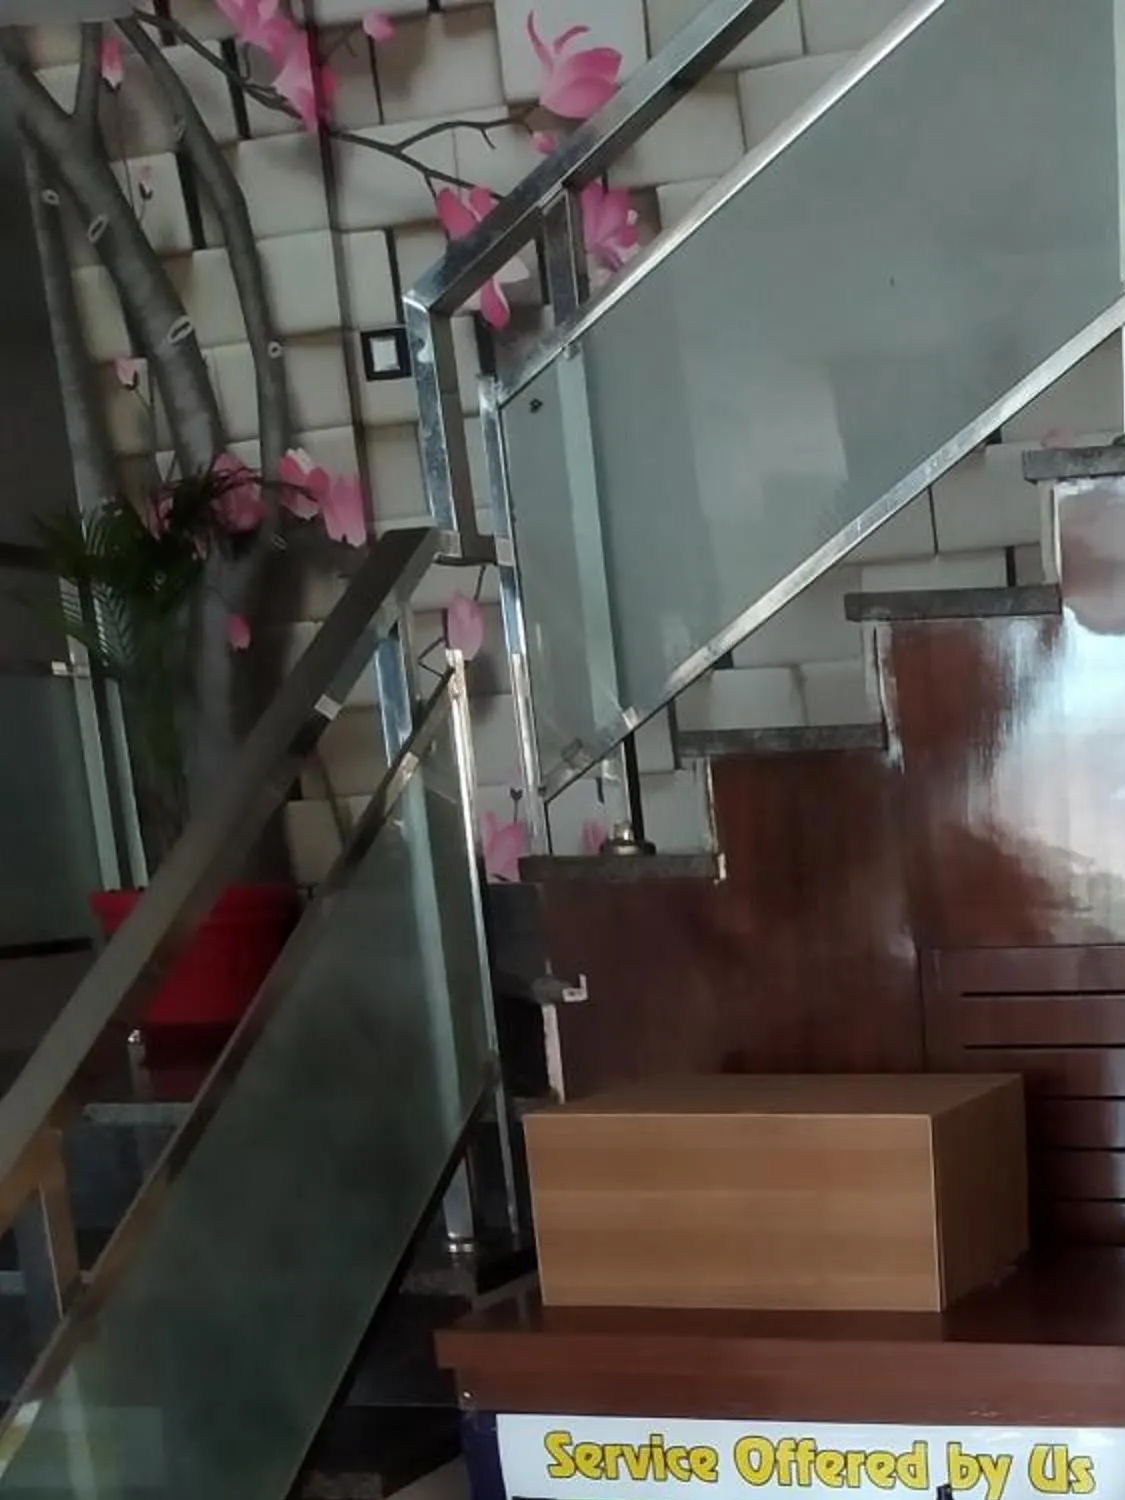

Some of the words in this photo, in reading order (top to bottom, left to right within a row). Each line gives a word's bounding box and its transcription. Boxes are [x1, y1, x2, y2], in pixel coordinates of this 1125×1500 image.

[543, 1430, 719, 1482] Service
[733, 1436, 929, 1489] Offered
[1028, 1442, 1095, 1494] Us
